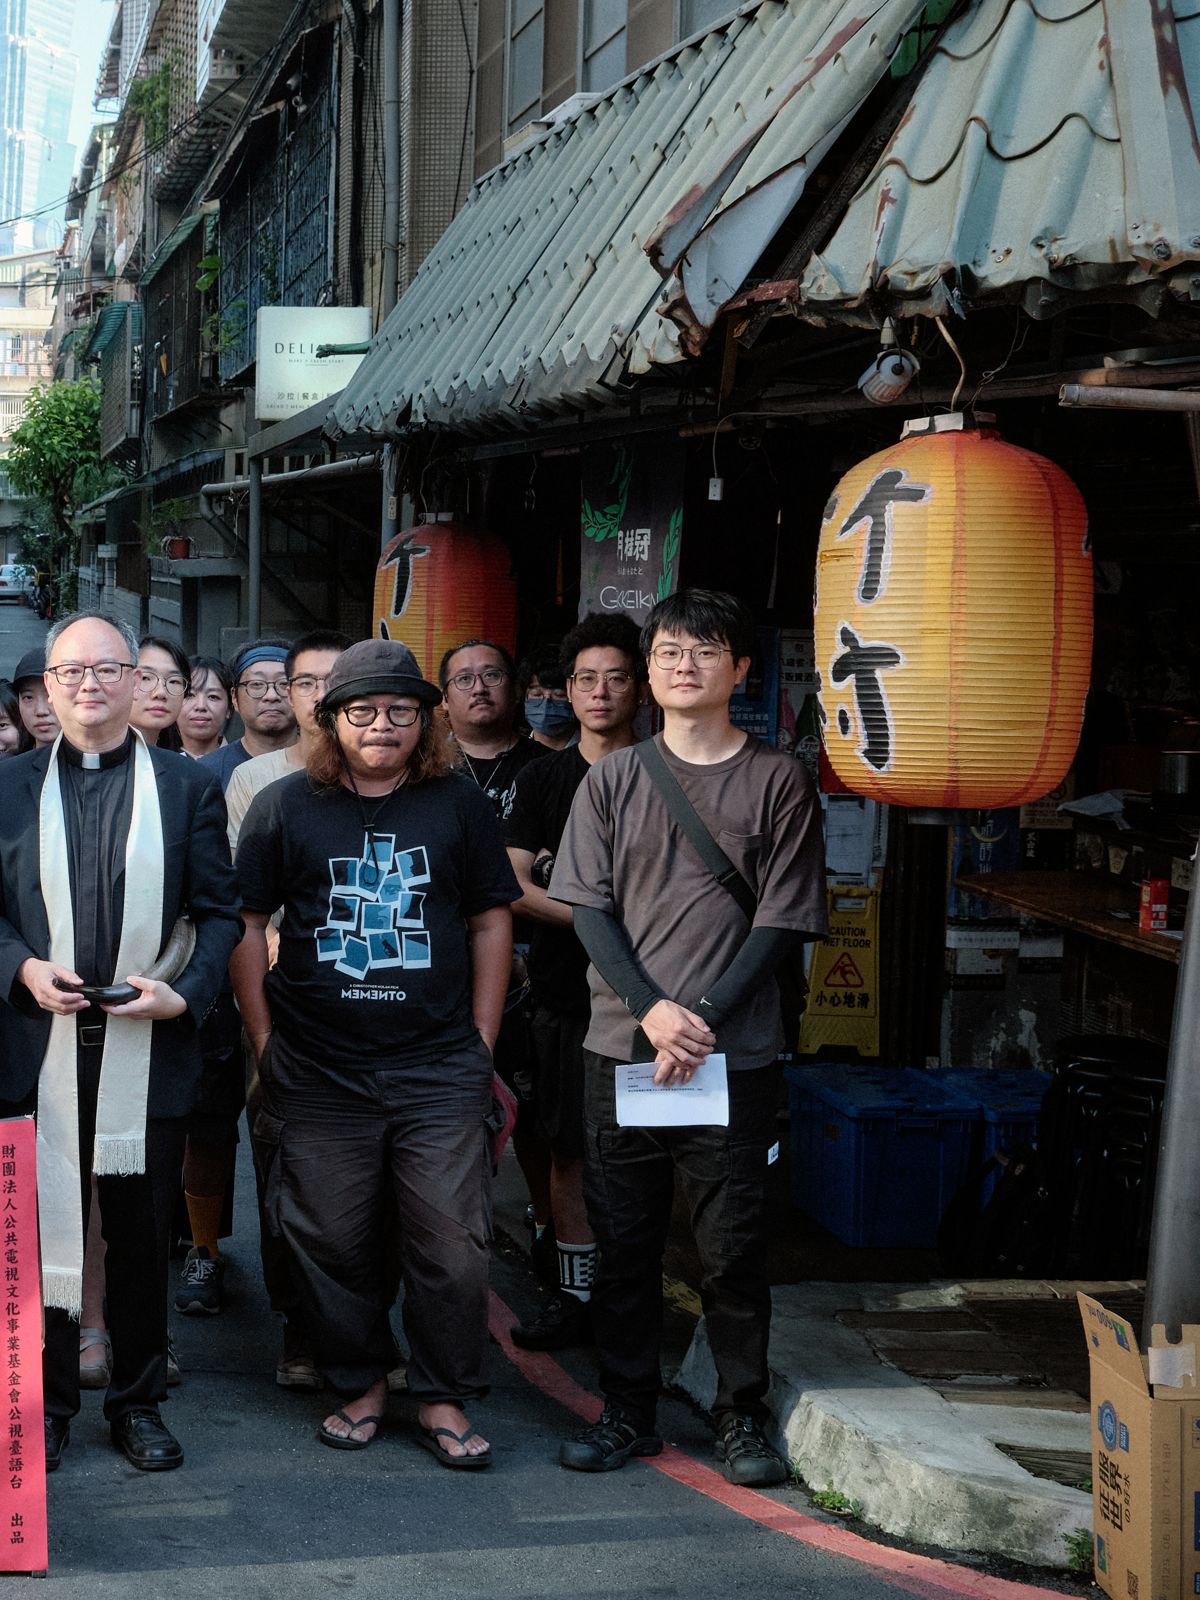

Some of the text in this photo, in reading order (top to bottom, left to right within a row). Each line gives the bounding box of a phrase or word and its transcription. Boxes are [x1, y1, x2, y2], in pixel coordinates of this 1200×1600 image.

[830, 926, 866, 937] CAUTION
[842, 938, 871, 948] FLOOR
[815, 990, 870, 1008] 小心地滑
[9, 1512, 25, 1545] 出品
